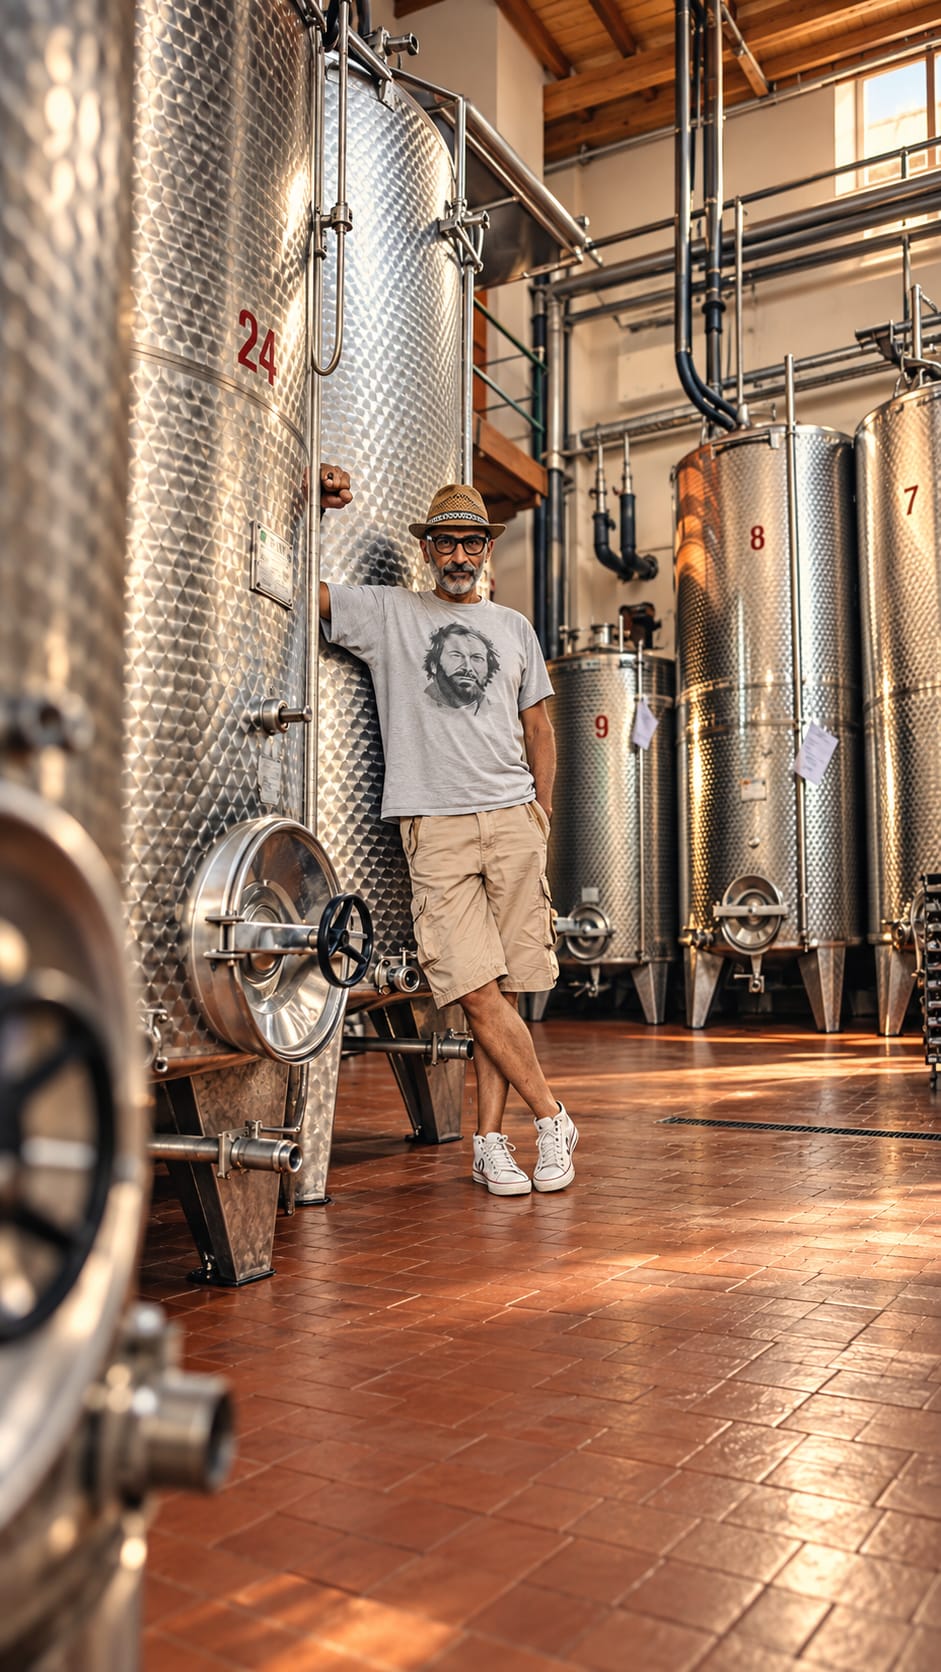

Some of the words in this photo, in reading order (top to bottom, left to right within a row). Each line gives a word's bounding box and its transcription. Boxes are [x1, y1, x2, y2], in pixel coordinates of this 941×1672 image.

[238, 309, 277, 386] 24
[904, 484, 919, 516] 7
[750, 525, 765, 551] 8
[595, 714, 609, 739] 9
